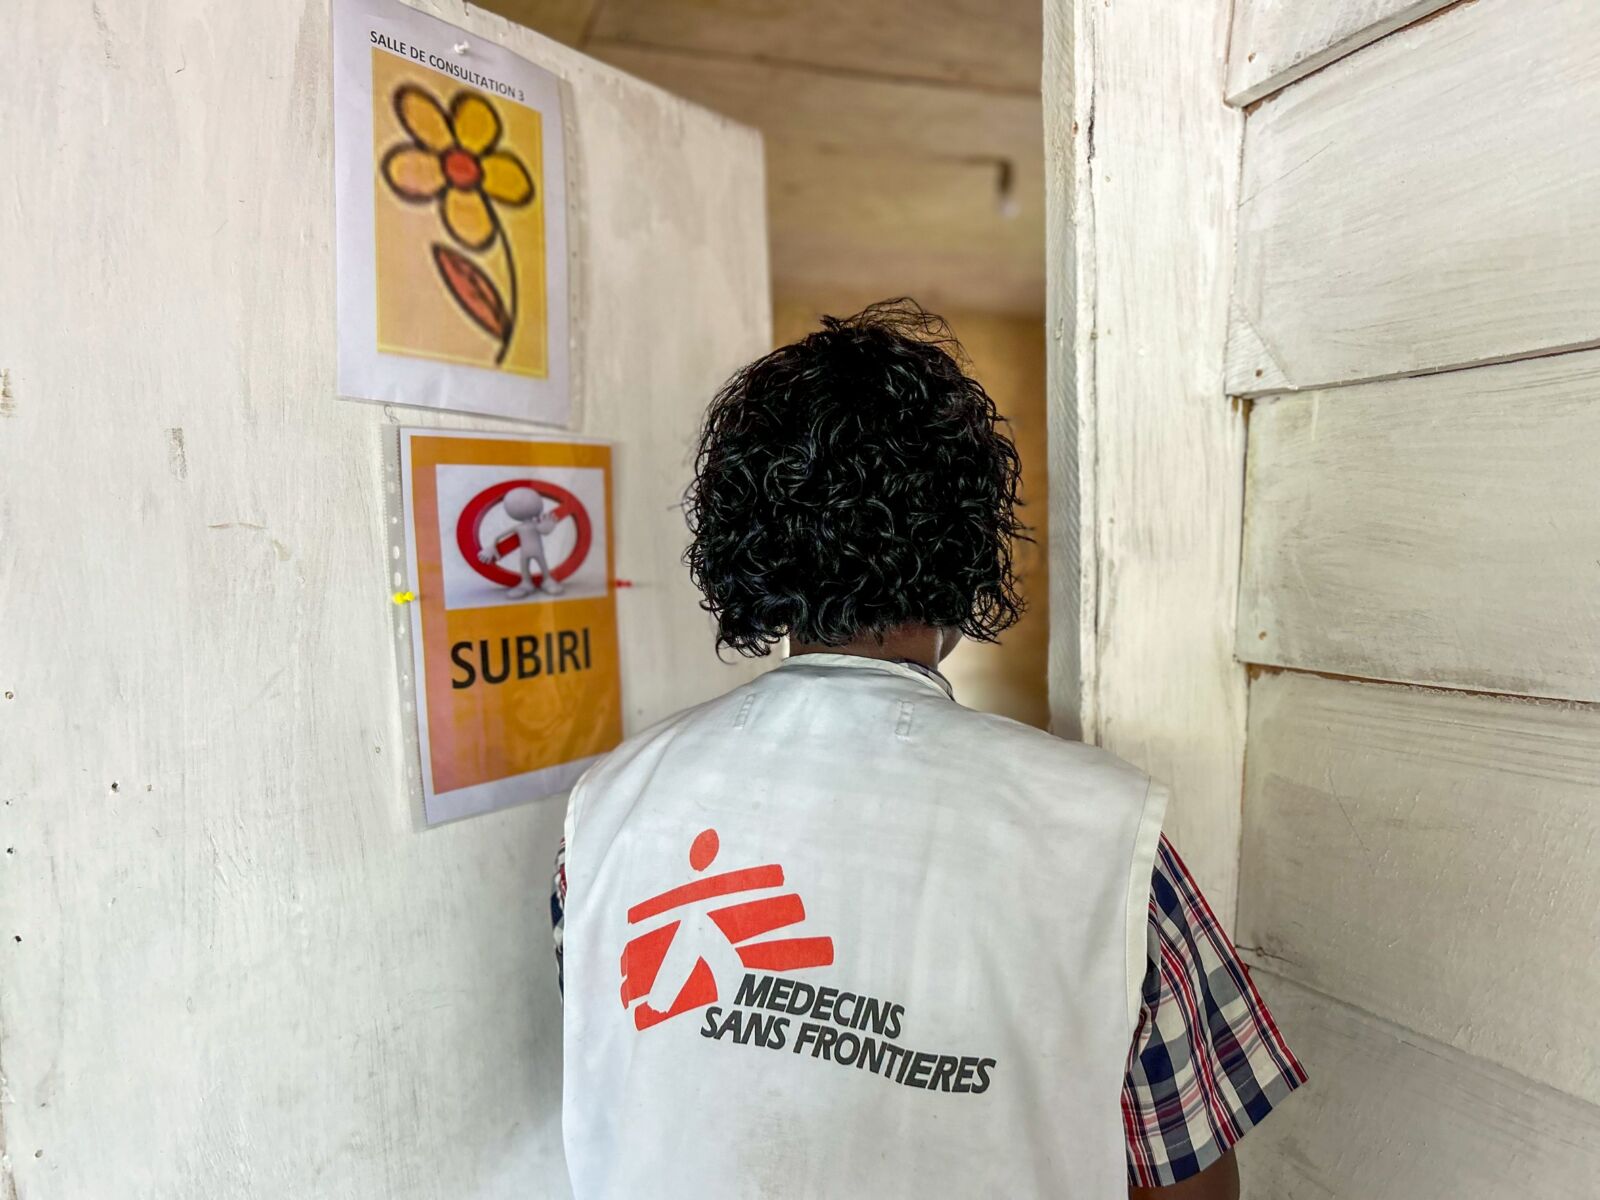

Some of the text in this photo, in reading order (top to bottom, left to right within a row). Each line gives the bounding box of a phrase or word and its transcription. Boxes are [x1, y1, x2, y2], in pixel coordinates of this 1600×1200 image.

[370, 30, 525, 102] SALLE DE CONSULTATION 3
[450, 627, 591, 690] SUBIRI
[733, 973, 905, 1039] MEDECINS
[700, 1006, 997, 1094] SANS FRONTIERES
